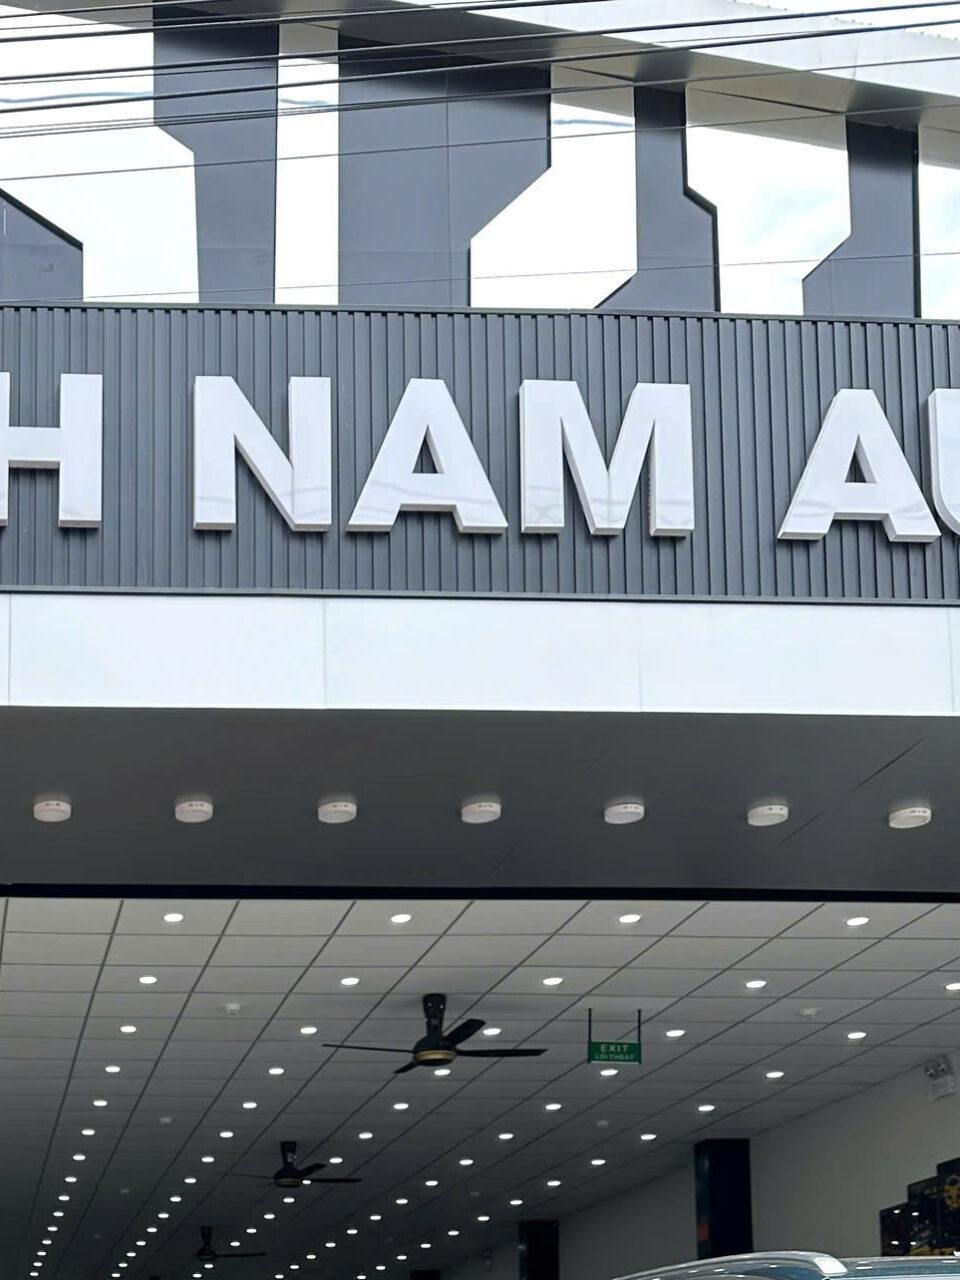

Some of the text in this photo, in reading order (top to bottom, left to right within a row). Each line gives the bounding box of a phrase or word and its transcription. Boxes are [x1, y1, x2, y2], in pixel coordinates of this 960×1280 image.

[193, 375, 696, 539] NAM
[777, 388, 960, 544] A
[600, 1044, 630, 1053] EXIT
